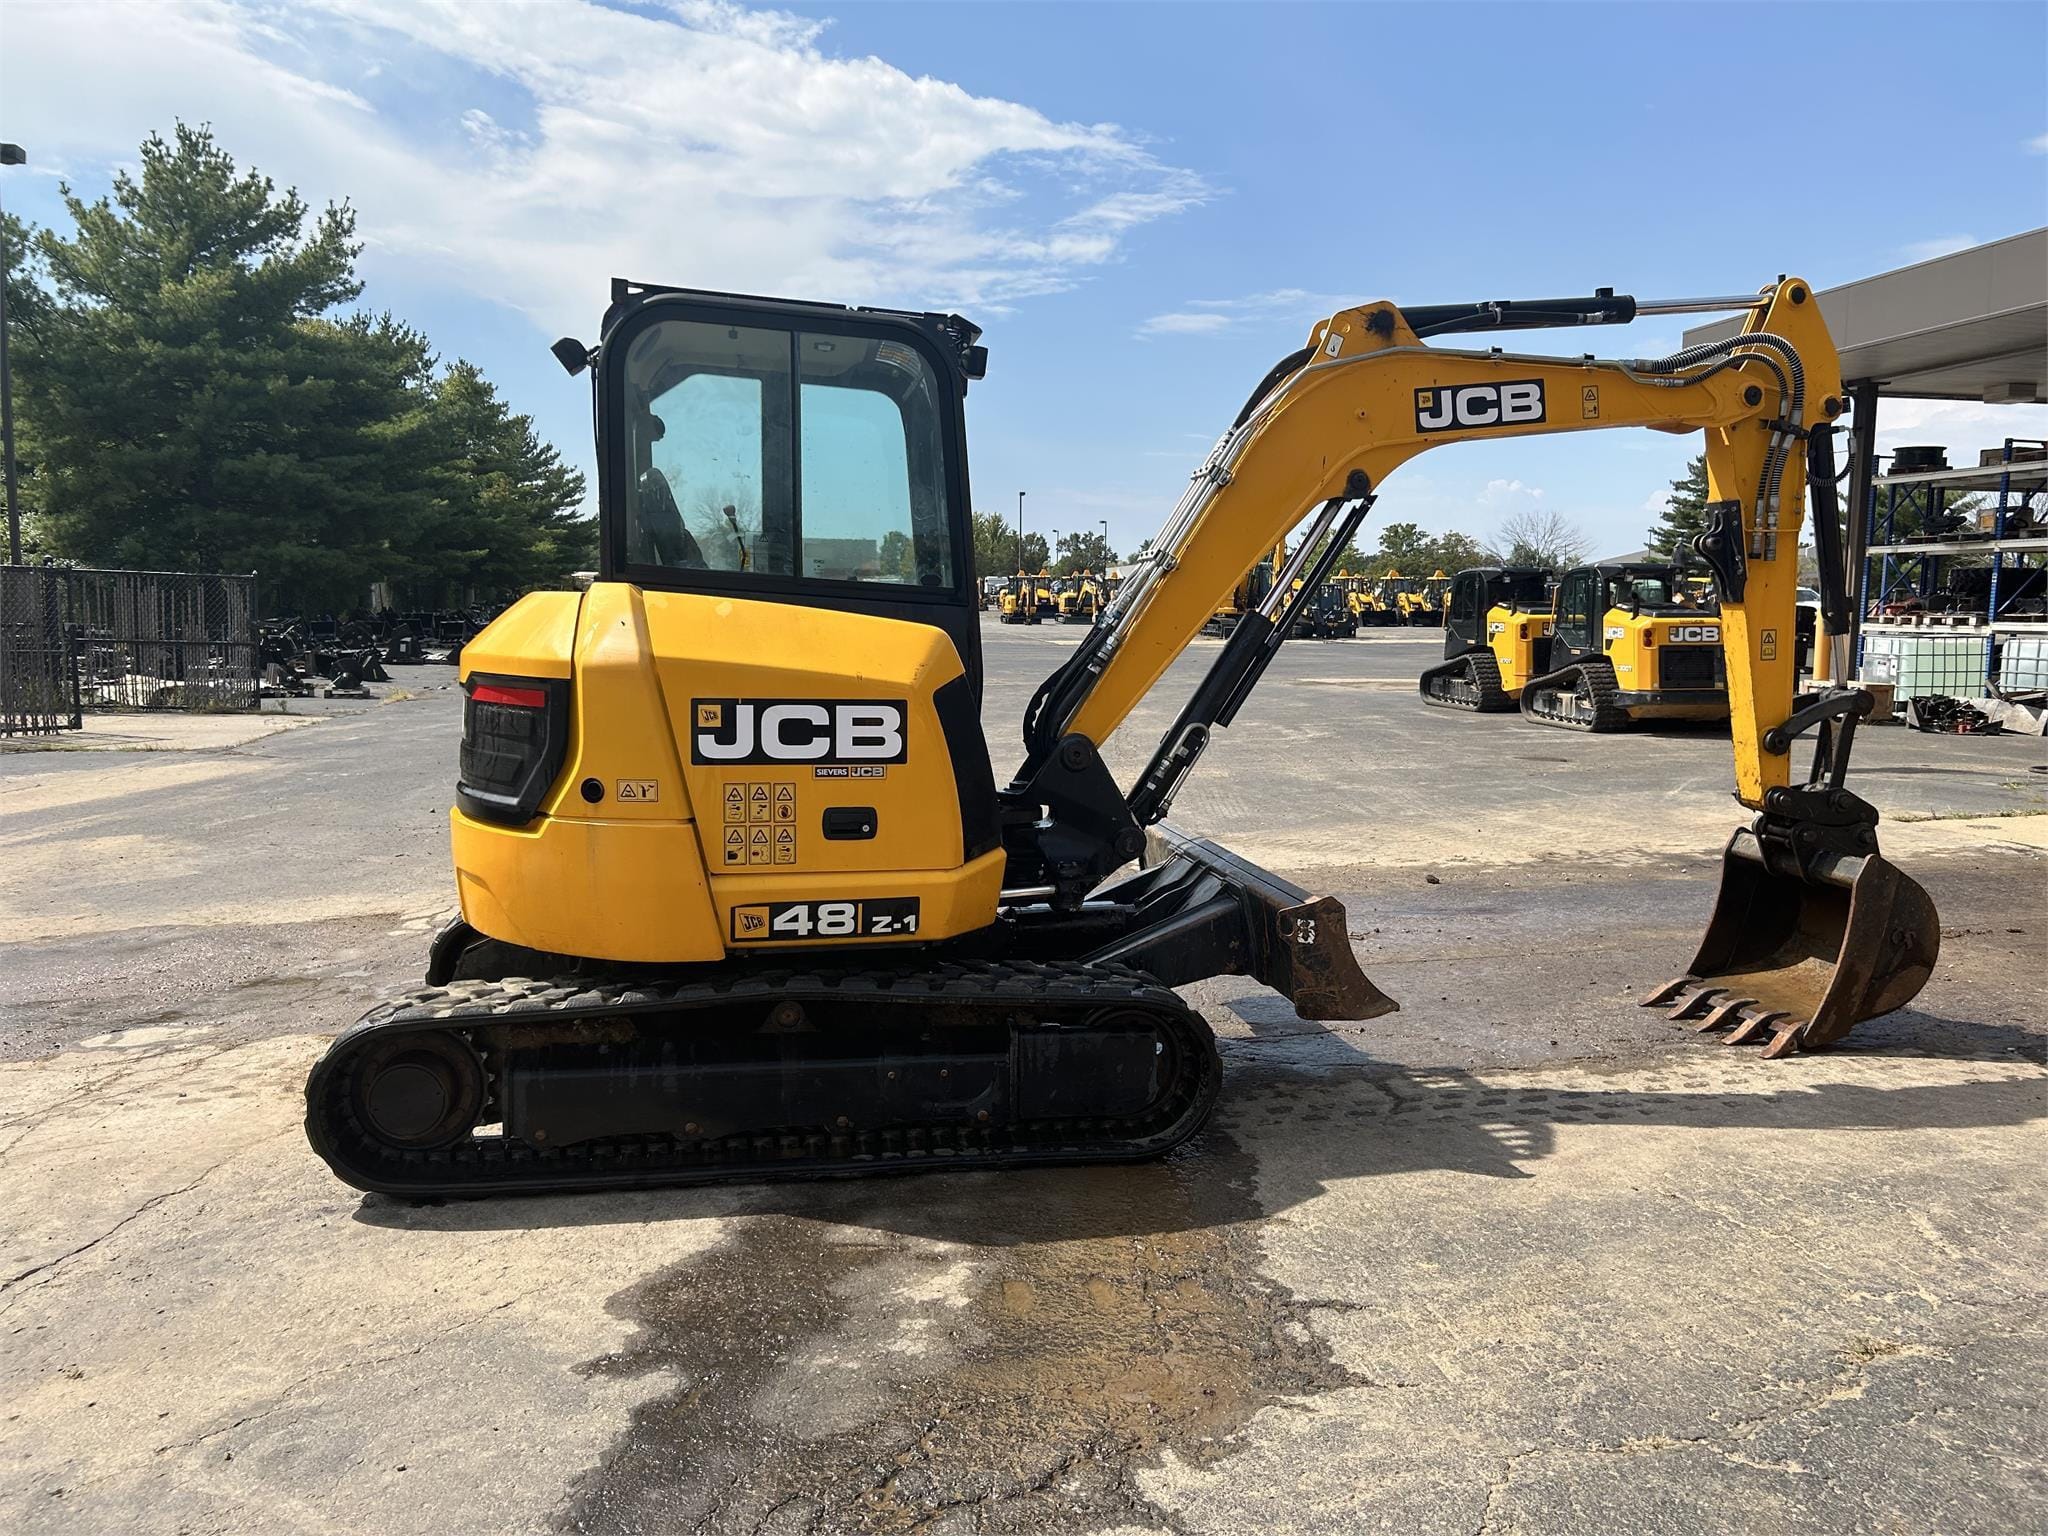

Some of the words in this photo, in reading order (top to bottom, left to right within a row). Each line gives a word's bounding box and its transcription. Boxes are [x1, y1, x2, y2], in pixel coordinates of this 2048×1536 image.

[1419, 383, 1543, 429] JCB
[1489, 622, 1505, 632] JCB
[1670, 627, 1719, 642] JCB
[697, 704, 903, 760] JCB
[816, 768, 848, 776] SIEVERS
[851, 767, 884, 777] JCB
[743, 914, 765, 931] JCB
[773, 903, 856, 936] 48
[871, 914, 917, 934] Z-1
